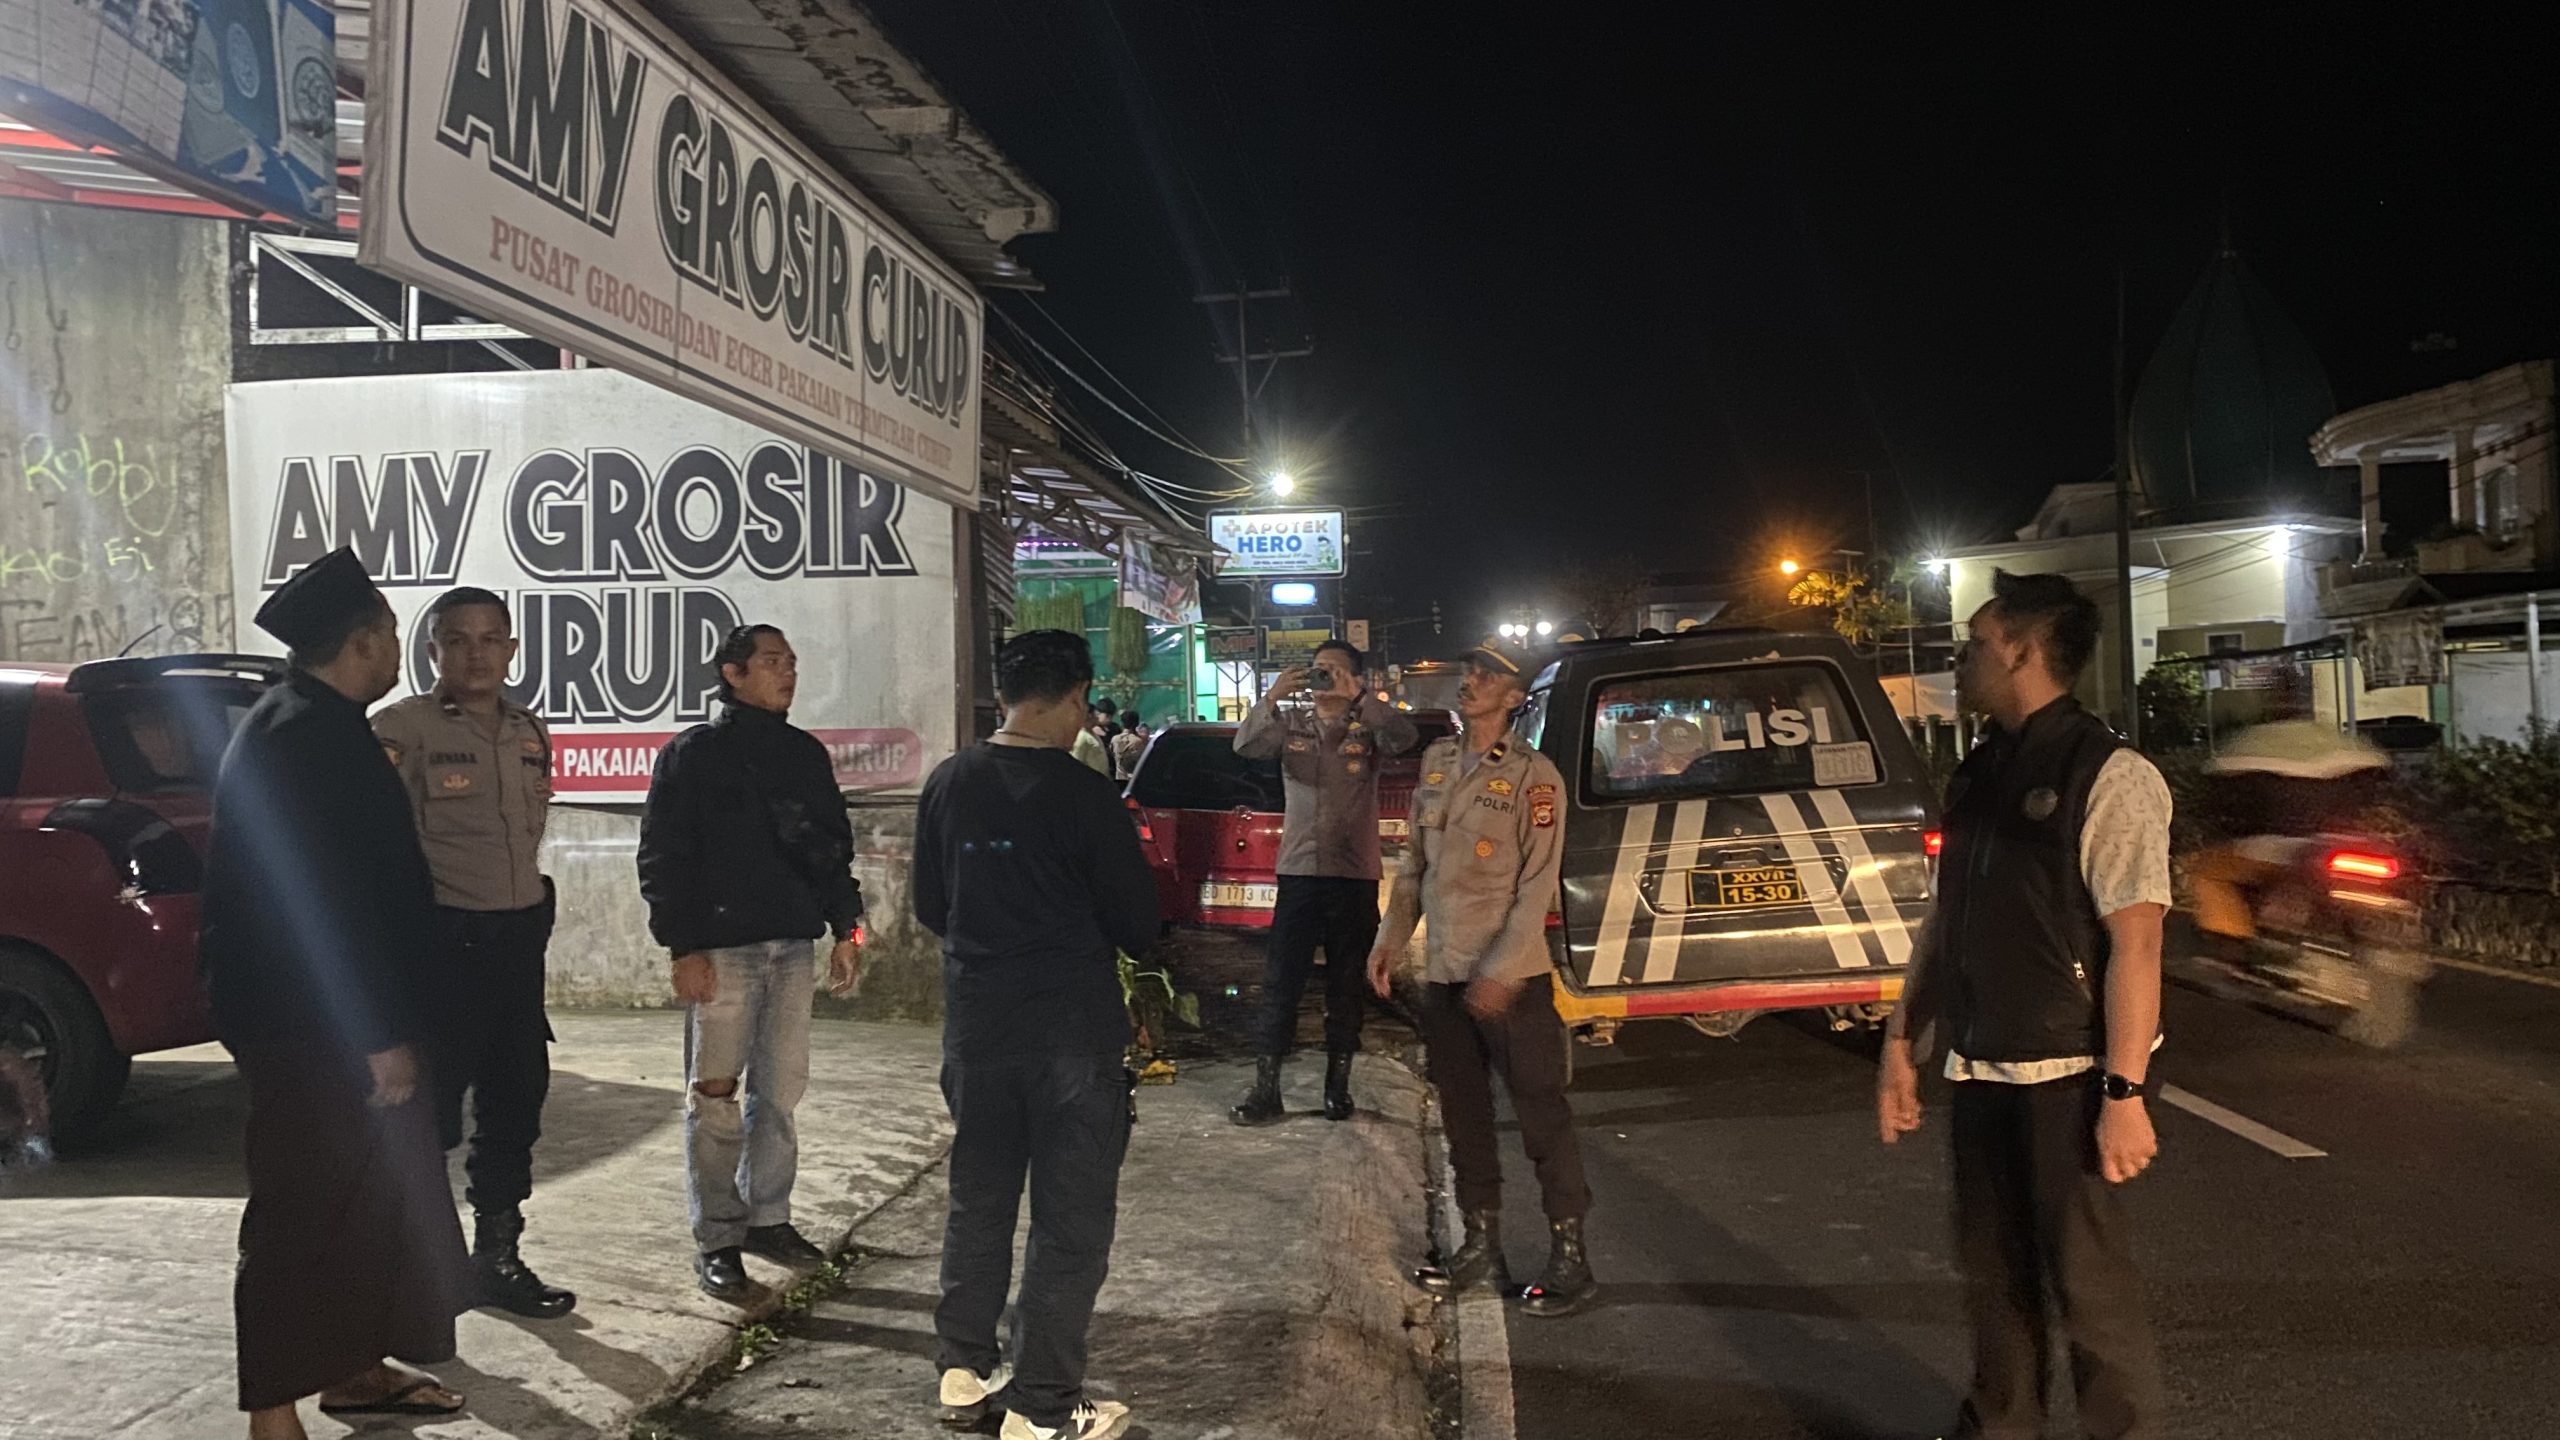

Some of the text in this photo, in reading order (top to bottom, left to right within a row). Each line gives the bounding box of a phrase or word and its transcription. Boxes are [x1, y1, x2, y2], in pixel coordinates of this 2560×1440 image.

[436, 0, 971, 429] AMY GROSIR CURUP
[489, 216, 580, 296] PUSAT
[585, 265, 676, 341] GROSIR
[678, 311, 721, 363] DAN
[725, 335, 773, 389] ECER
[777, 361, 843, 421] PAKAIAN
[261, 440, 919, 592] AMY GROSIR
[1245, 520, 1329, 535] APOTEK
[1238, 535, 1303, 553] HERO
[1615, 706, 1832, 759] POLISI
[1473, 795, 1515, 815] POLRI
[1226, 887, 1254, 901] 1713
[1260, 888, 1275, 902] KC
[1728, 885, 1792, 903] 15-30
